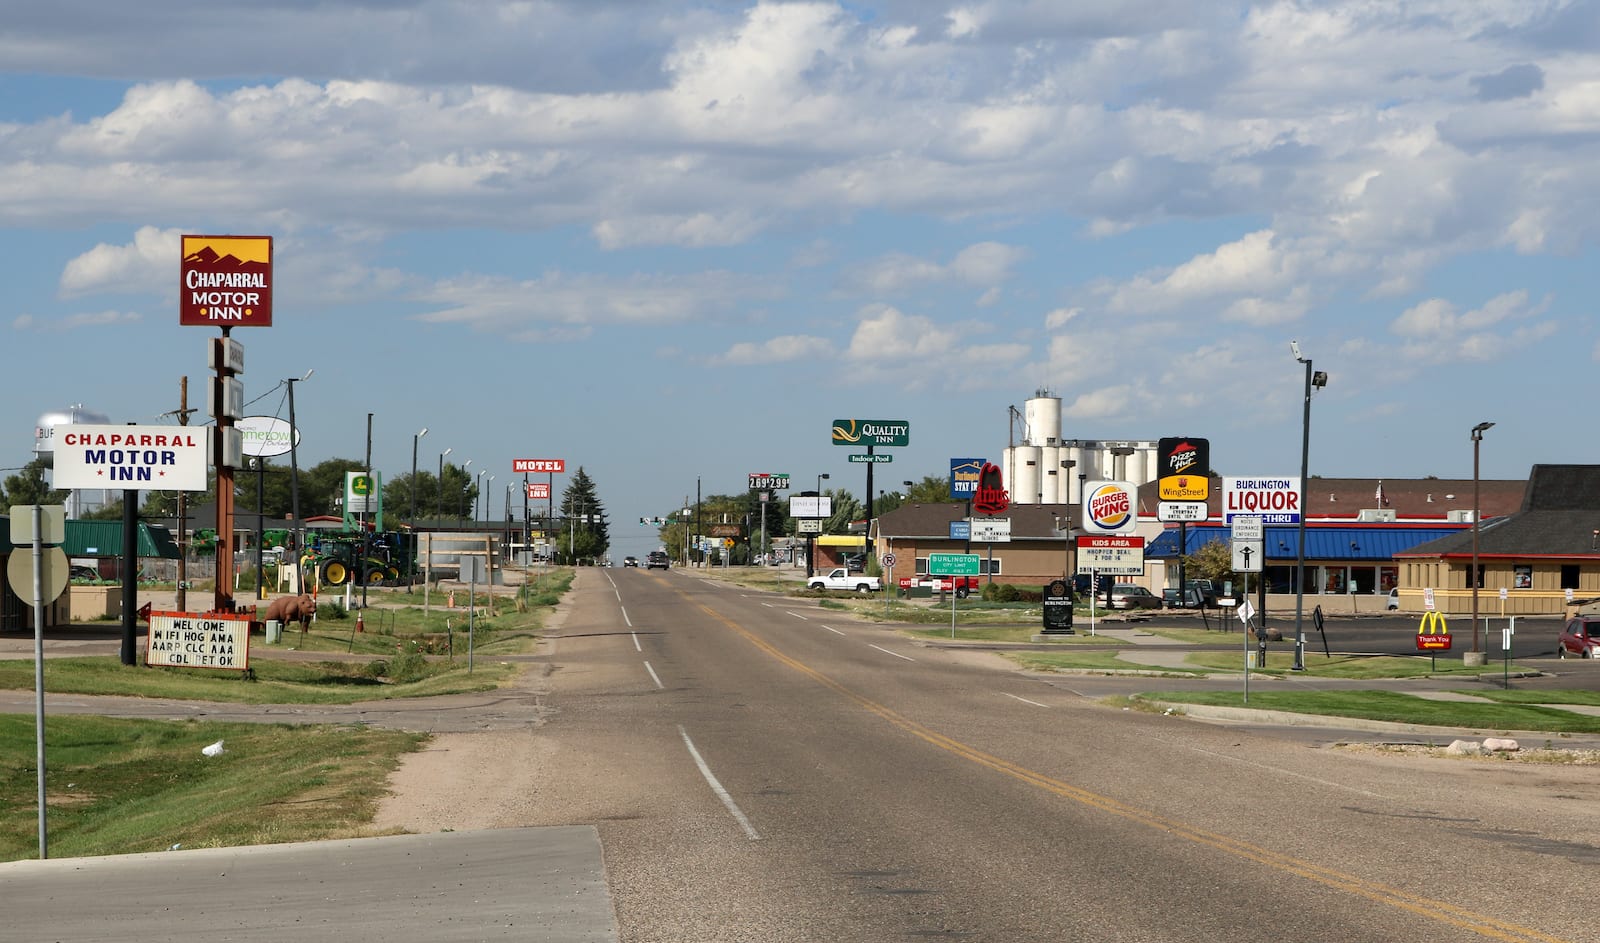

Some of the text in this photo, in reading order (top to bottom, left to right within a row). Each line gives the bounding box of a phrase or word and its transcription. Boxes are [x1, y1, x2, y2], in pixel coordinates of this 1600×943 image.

[186, 270, 267, 289] CHAPARRAL
[192, 292, 259, 305] MOTOR
[209, 307, 242, 320] INN
[862, 424, 907, 436] QUALITY
[65, 434, 196, 447] CHAPARRAL
[86, 450, 175, 465] MOTOR
[1170, 450, 1196, 467] Pizza
[1175, 458, 1194, 470] Hut
[516, 461, 561, 470] MOTEL
[110, 467, 151, 480] INN
[955, 482, 970, 491] STAY
[1236, 480, 1290, 489] BURLINGTON
[1163, 488, 1204, 497] WingStreet
[1092, 492, 1128, 508] BURGER
[1228, 491, 1298, 512] LIQUOR
[1093, 501, 1129, 521] KING
[184, 632, 204, 641] HOG
[210, 634, 233, 643] AMA
[152, 642, 233, 654] AARP CLC AAA
[170, 654, 188, 663] CDL
[219, 657, 233, 666] OK
